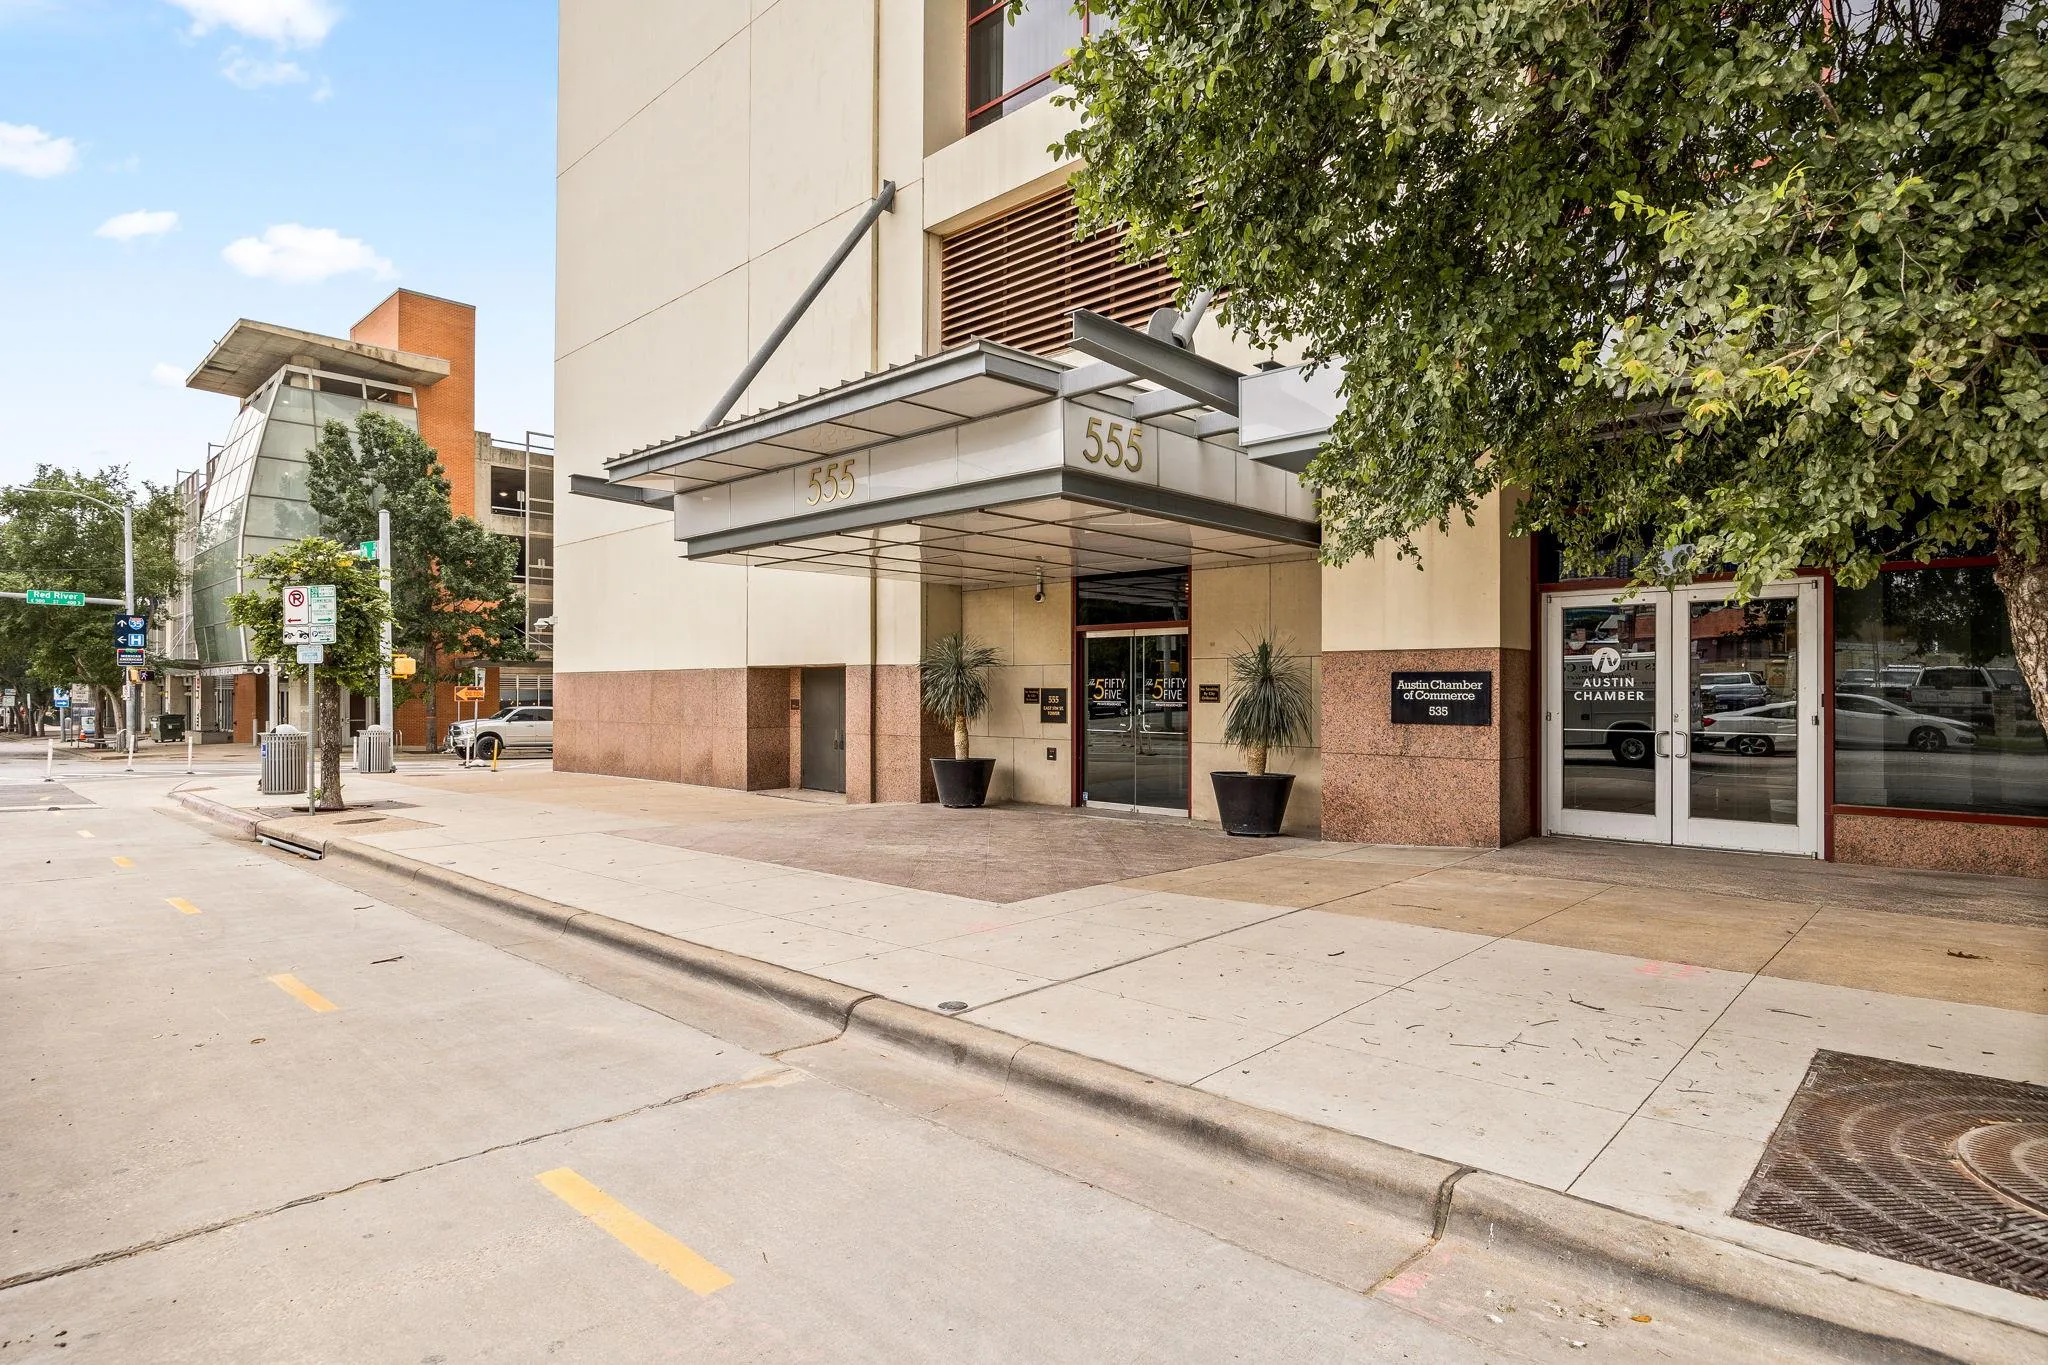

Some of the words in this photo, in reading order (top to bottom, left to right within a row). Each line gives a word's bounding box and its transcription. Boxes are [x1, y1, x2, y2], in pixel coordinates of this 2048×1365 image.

[1082, 416, 1144, 473] 555
[806, 459, 856, 507] 555
[33, 591, 51, 599] Red
[53, 591, 78, 600] River
[130, 621, 142, 629] 35
[131, 635, 142, 645] H
[1397, 680, 1430, 691] Austin
[1430, 679, 1483, 691] Chamber
[1582, 677, 1635, 688] AUSTIN
[1093, 678, 1105, 700] 5
[1104, 678, 1126, 689] FIFTY
[1151, 678, 1164, 700] 5
[1163, 677, 1187, 689] FIFTY
[1048, 695, 1060, 704] 555
[1104, 689, 1122, 700] FIVE
[1163, 689, 1183, 700] FIVE
[1403, 690, 1415, 700] of
[1415, 690, 1475, 701] Commerce
[1574, 691, 1645, 701] CHAMBER
[1428, 706, 1448, 717] 535
